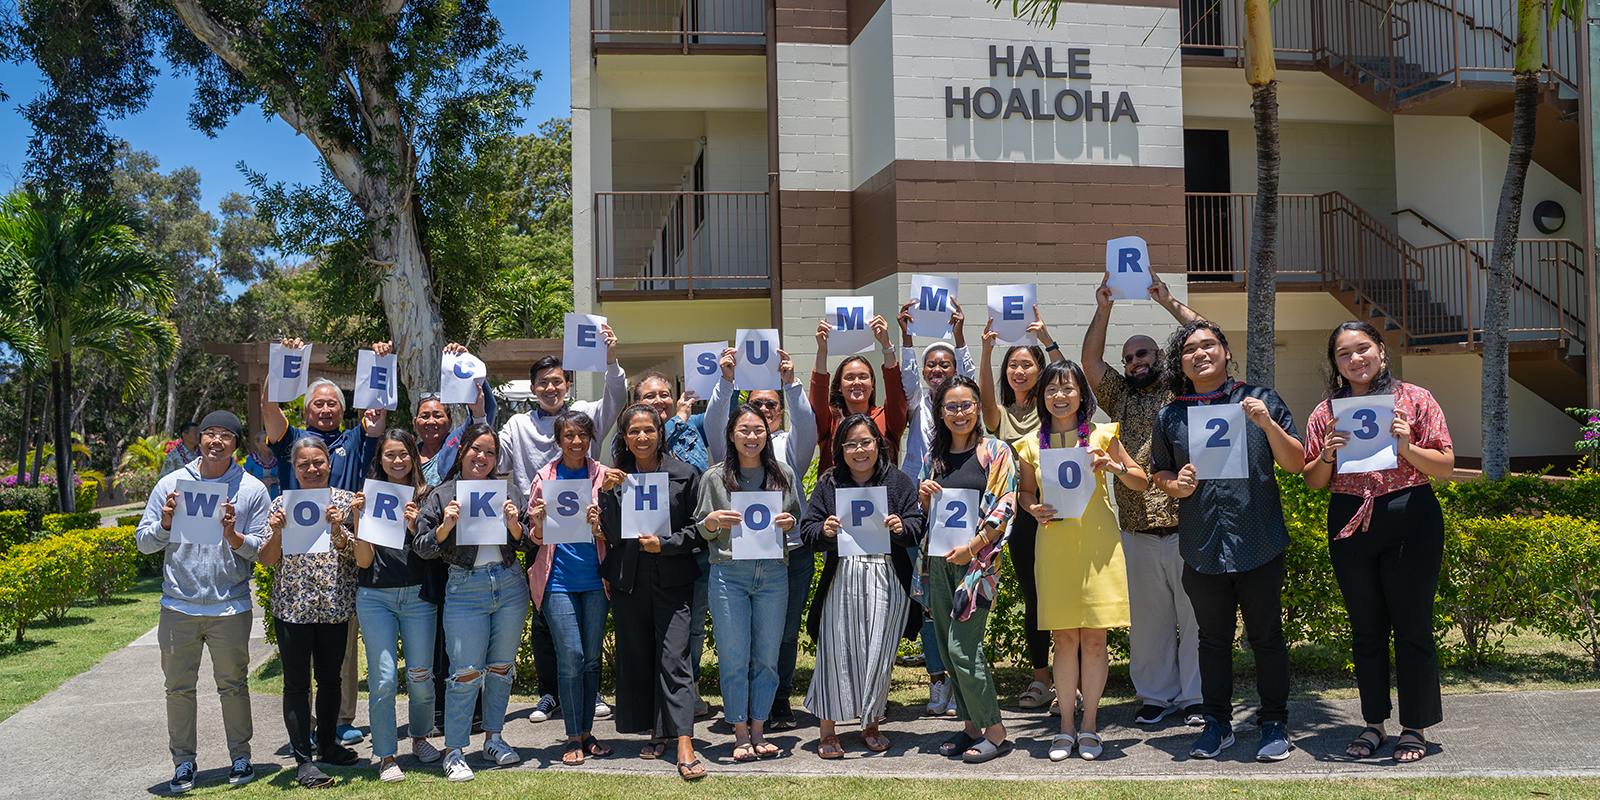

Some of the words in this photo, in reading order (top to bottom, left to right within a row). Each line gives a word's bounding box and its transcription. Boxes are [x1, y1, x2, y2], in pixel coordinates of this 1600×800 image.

[989, 45, 1092, 79] HALE
[945, 86, 1139, 123] HOALOHA
[1117, 248, 1144, 273] R
[919, 286, 948, 312] M
[1003, 296, 1024, 320] E
[837, 307, 864, 331] M
[577, 324, 597, 348] E
[697, 353, 718, 375] S
[746, 340, 769, 365] U
[283, 355, 302, 378] E
[370, 366, 388, 389] E
[453, 360, 475, 379] C
[1205, 418, 1231, 448] 2
[1352, 409, 1379, 440] 3
[1058, 461, 1081, 489] 0
[184, 491, 220, 518] W
[373, 493, 399, 521] R
[470, 492, 498, 517] K
[557, 491, 580, 516] S
[634, 485, 658, 511] H
[293, 501, 320, 526] O
[744, 504, 771, 530] O
[851, 500, 874, 527] P
[944, 501, 967, 528] 2
